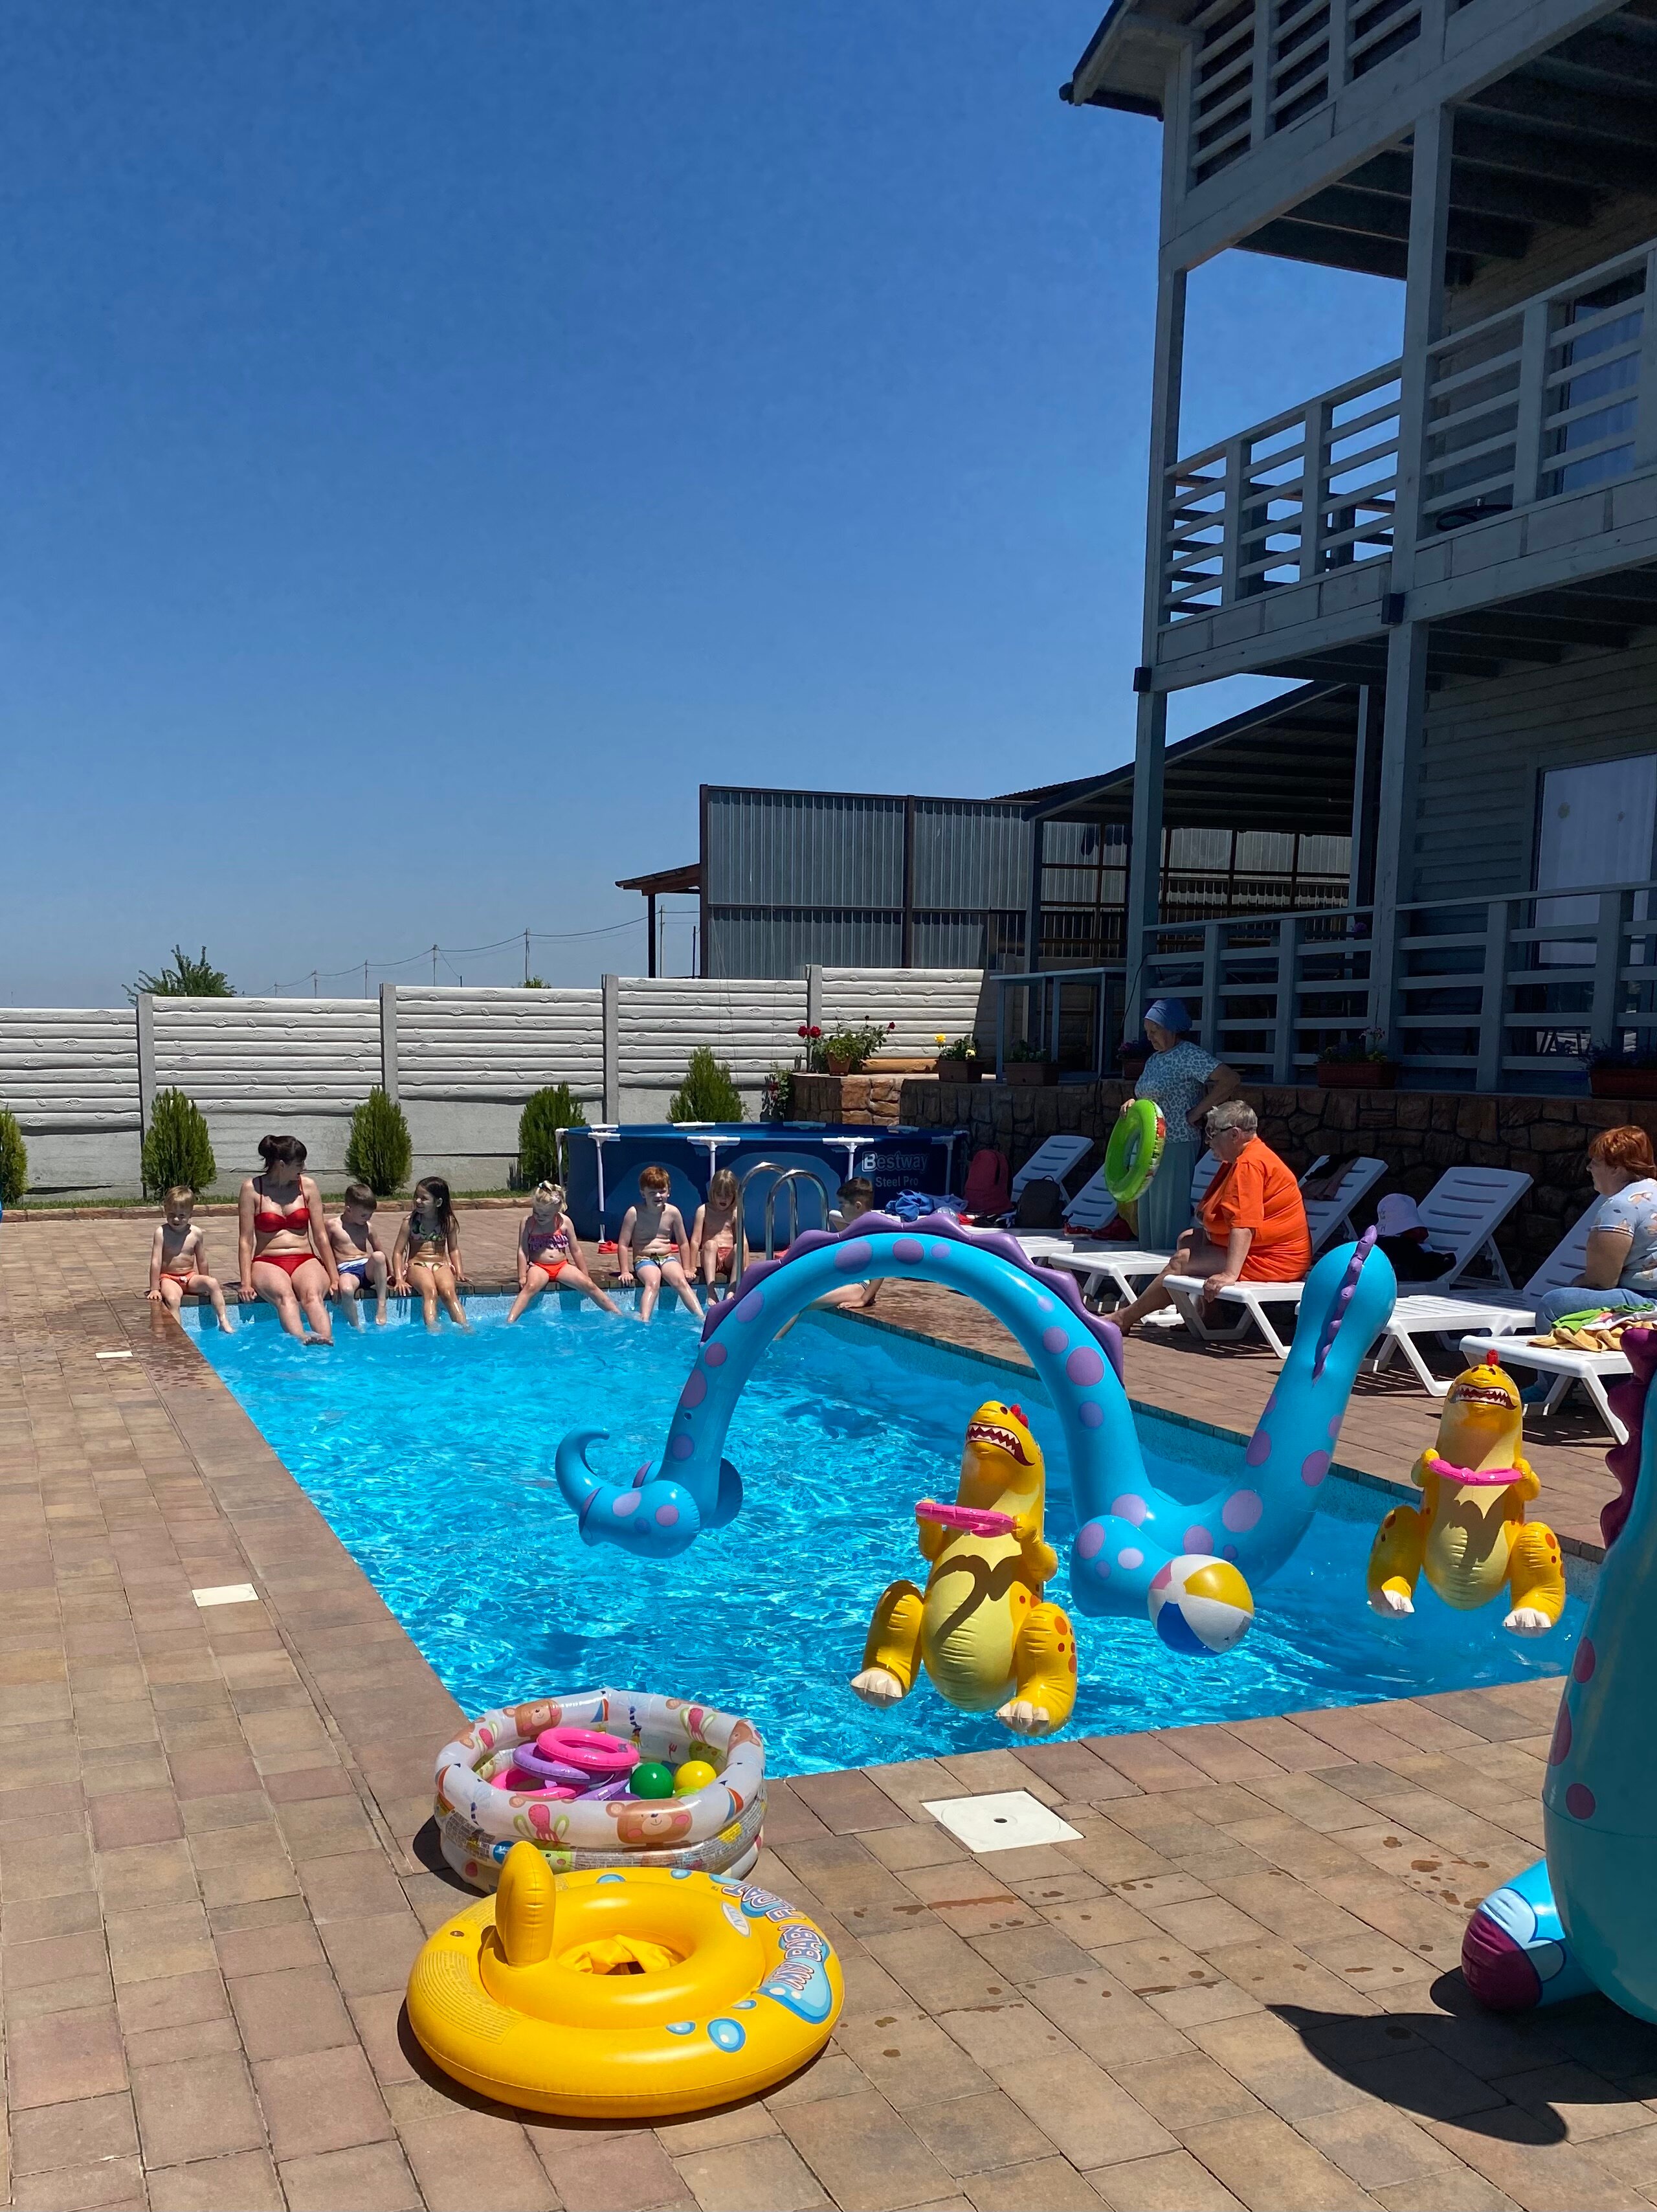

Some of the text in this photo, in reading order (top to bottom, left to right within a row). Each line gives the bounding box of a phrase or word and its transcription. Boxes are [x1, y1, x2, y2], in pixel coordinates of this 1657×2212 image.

[862, 1151, 929, 1174] Bestway
[875, 1176, 919, 1187] Steel Pro
[722, 1882, 806, 1923] FLOAT
[777, 1924, 823, 1961] BABY
[770, 1961, 814, 1991] MY
